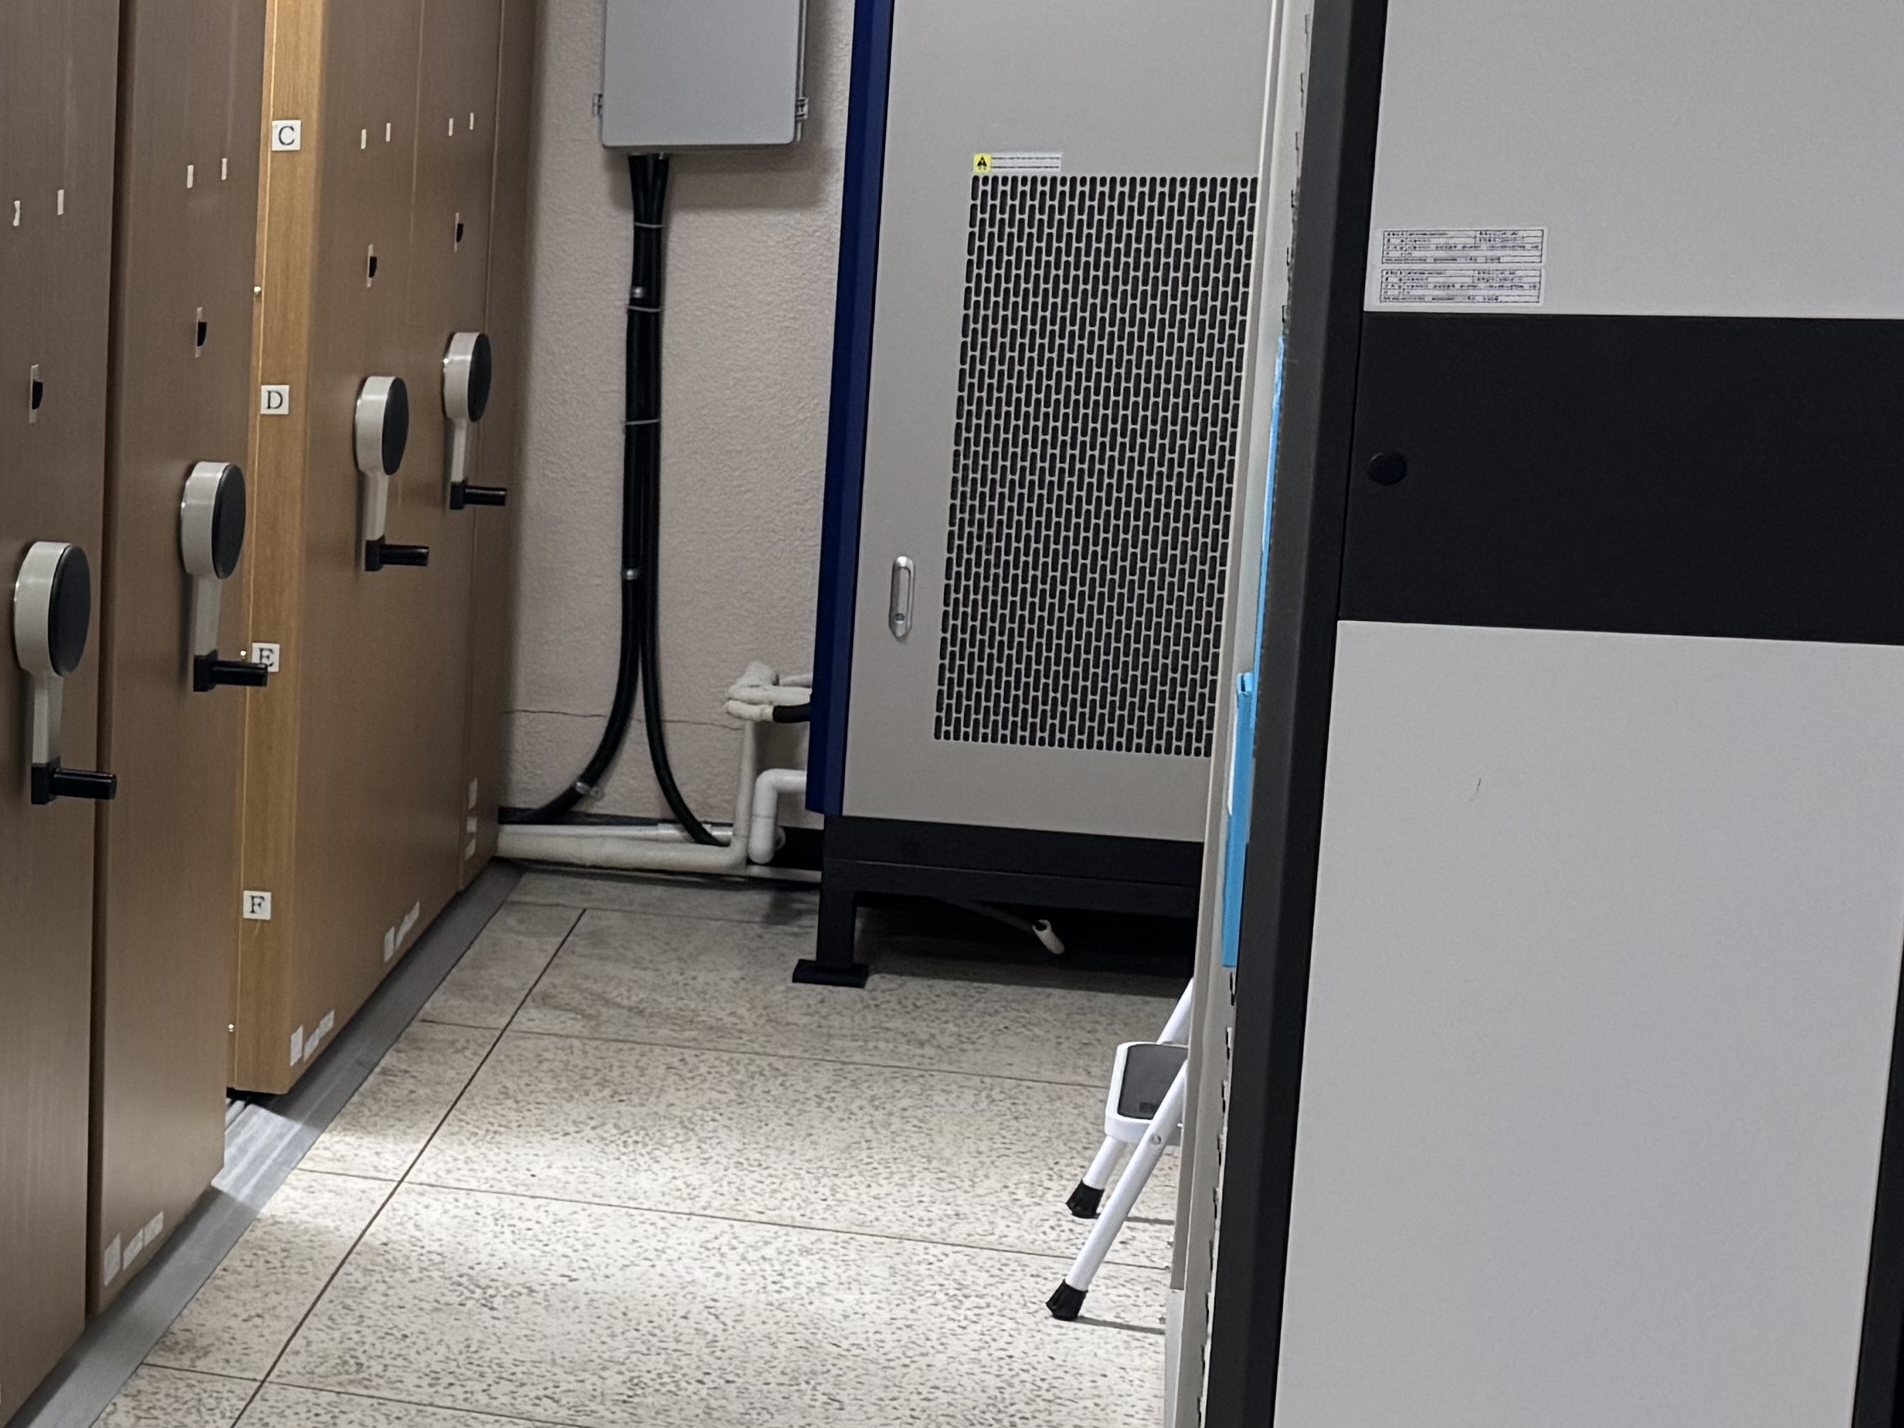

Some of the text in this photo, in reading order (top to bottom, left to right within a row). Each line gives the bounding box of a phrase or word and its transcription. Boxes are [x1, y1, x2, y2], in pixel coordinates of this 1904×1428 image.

[278, 126, 295, 146] C
[266, 390, 284, 410] D
[258, 648, 275, 668] E
[249, 895, 265, 914] F
